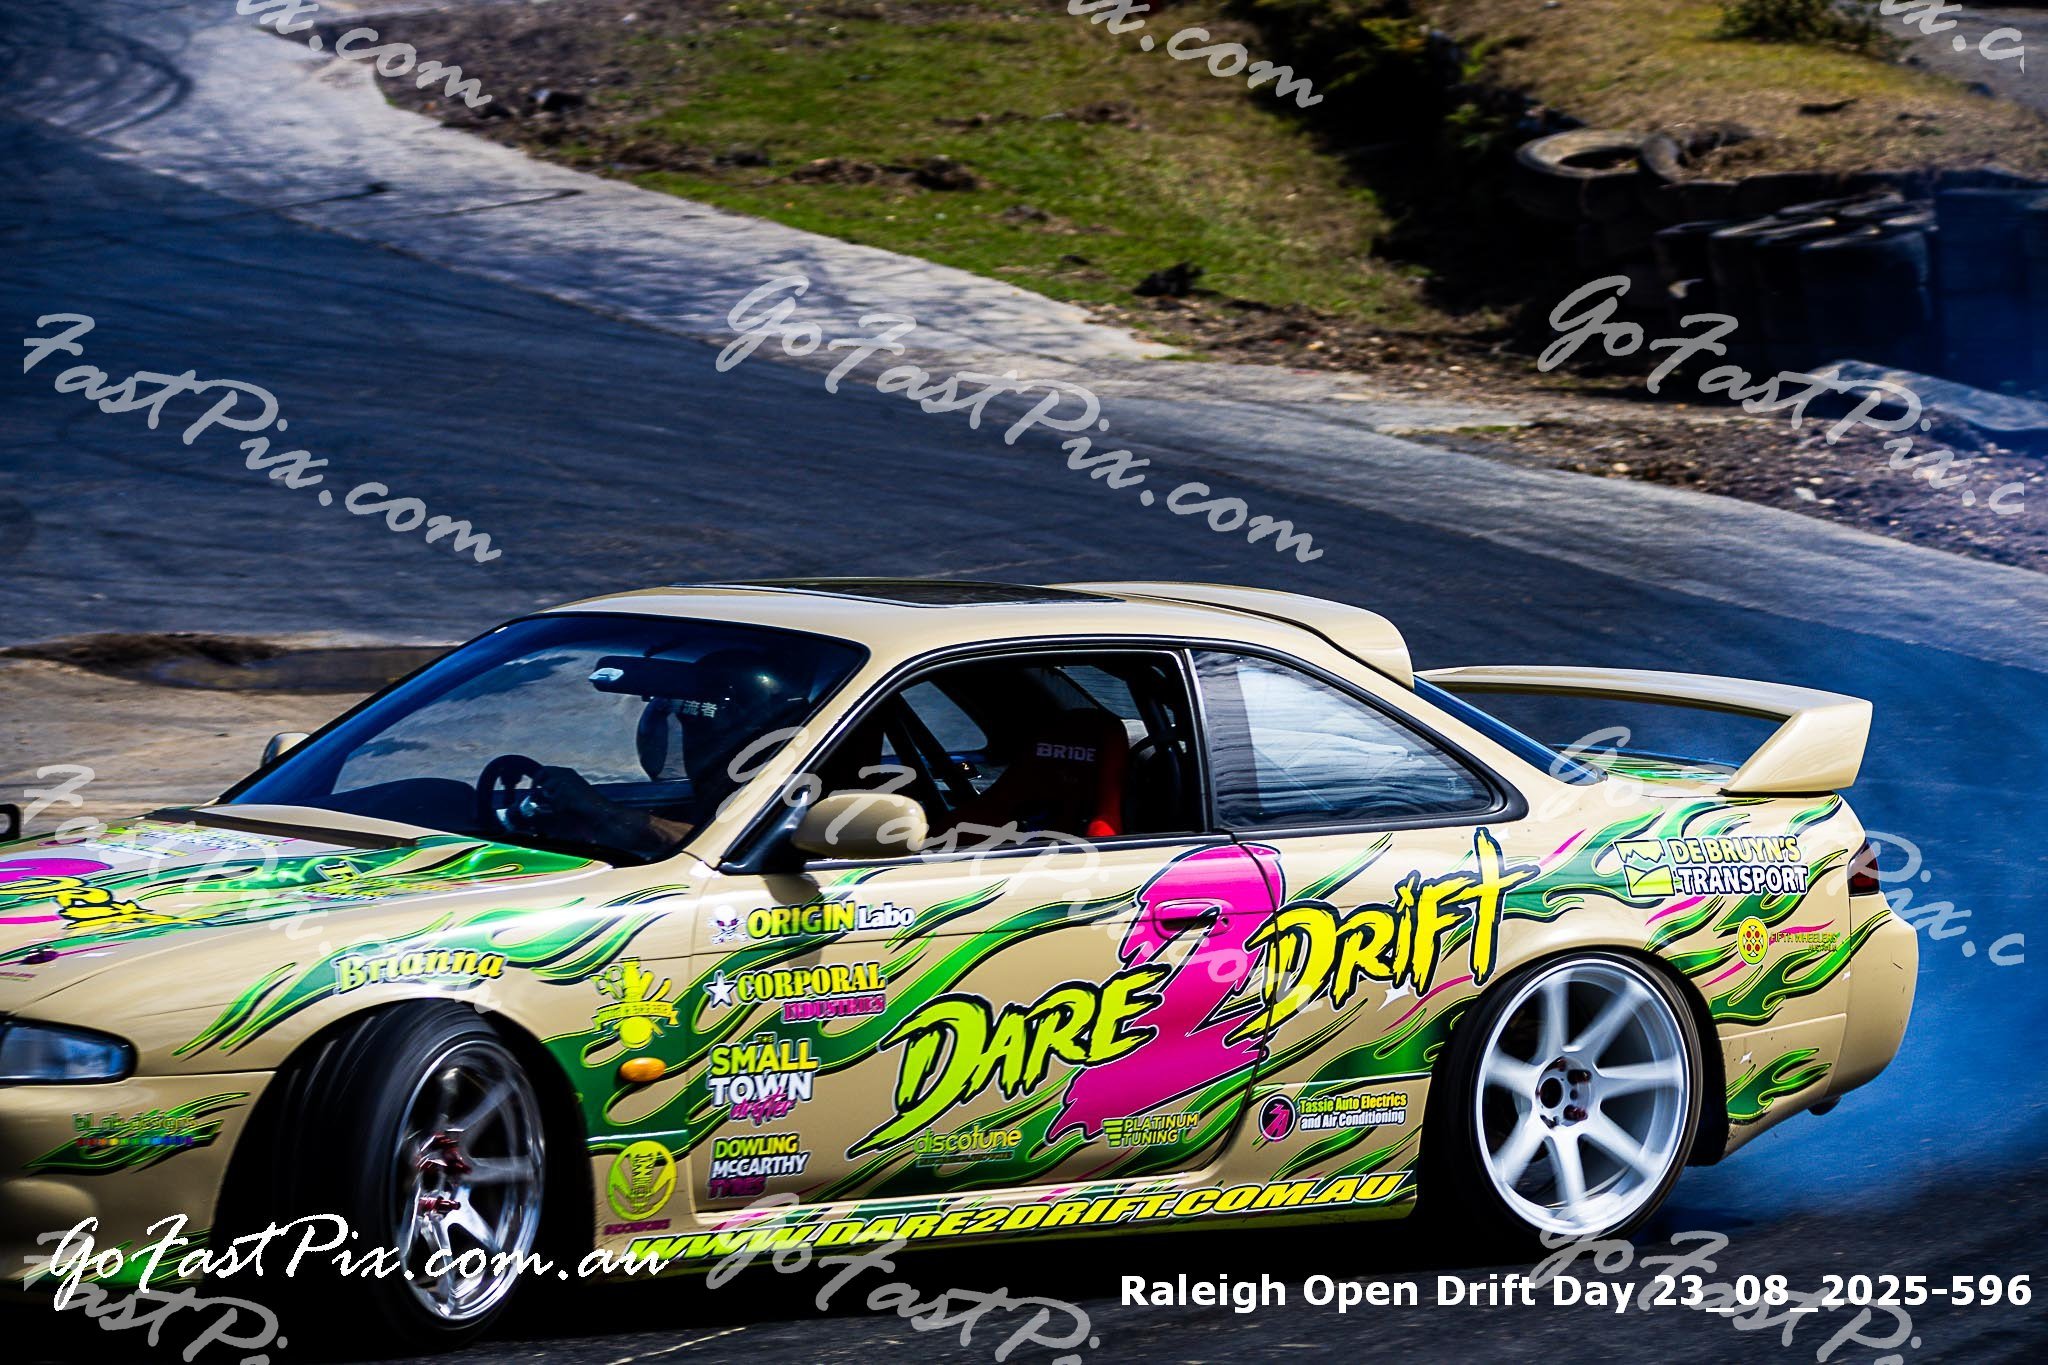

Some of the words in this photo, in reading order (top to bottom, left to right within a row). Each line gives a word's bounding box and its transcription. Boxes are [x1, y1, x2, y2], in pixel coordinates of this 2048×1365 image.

[1036, 742, 1097, 761] BRIDE
[1667, 838, 1703, 864] DE
[1703, 837, 1801, 864] BRUYN'S
[1676, 866, 1808, 894] TRANSPORT
[747, 901, 855, 939] ORIGIN
[858, 903, 915, 930] Labo
[334, 948, 505, 993] Brianna
[737, 962, 886, 1001] CORPORAL
[783, 996, 886, 1022] INDUSTRIES
[711, 1041, 819, 1075] SMALL
[848, 966, 1168, 1157] DARE
[708, 1072, 813, 1106] TOWN
[1301, 1098, 1333, 1114] Tassie
[1335, 1096, 1359, 1111] Auto
[1361, 1093, 1407, 1110] Electrics
[1124, 1113, 1199, 1131] PLATINUM
[1301, 1114, 1321, 1129] and
[1322, 1114, 1337, 1128] Air
[1339, 1110, 1405, 1126] Conditioning
[714, 1135, 798, 1158] DOWLING
[914, 1124, 1022, 1153] discotune
[1123, 1129, 1177, 1146] TUNING
